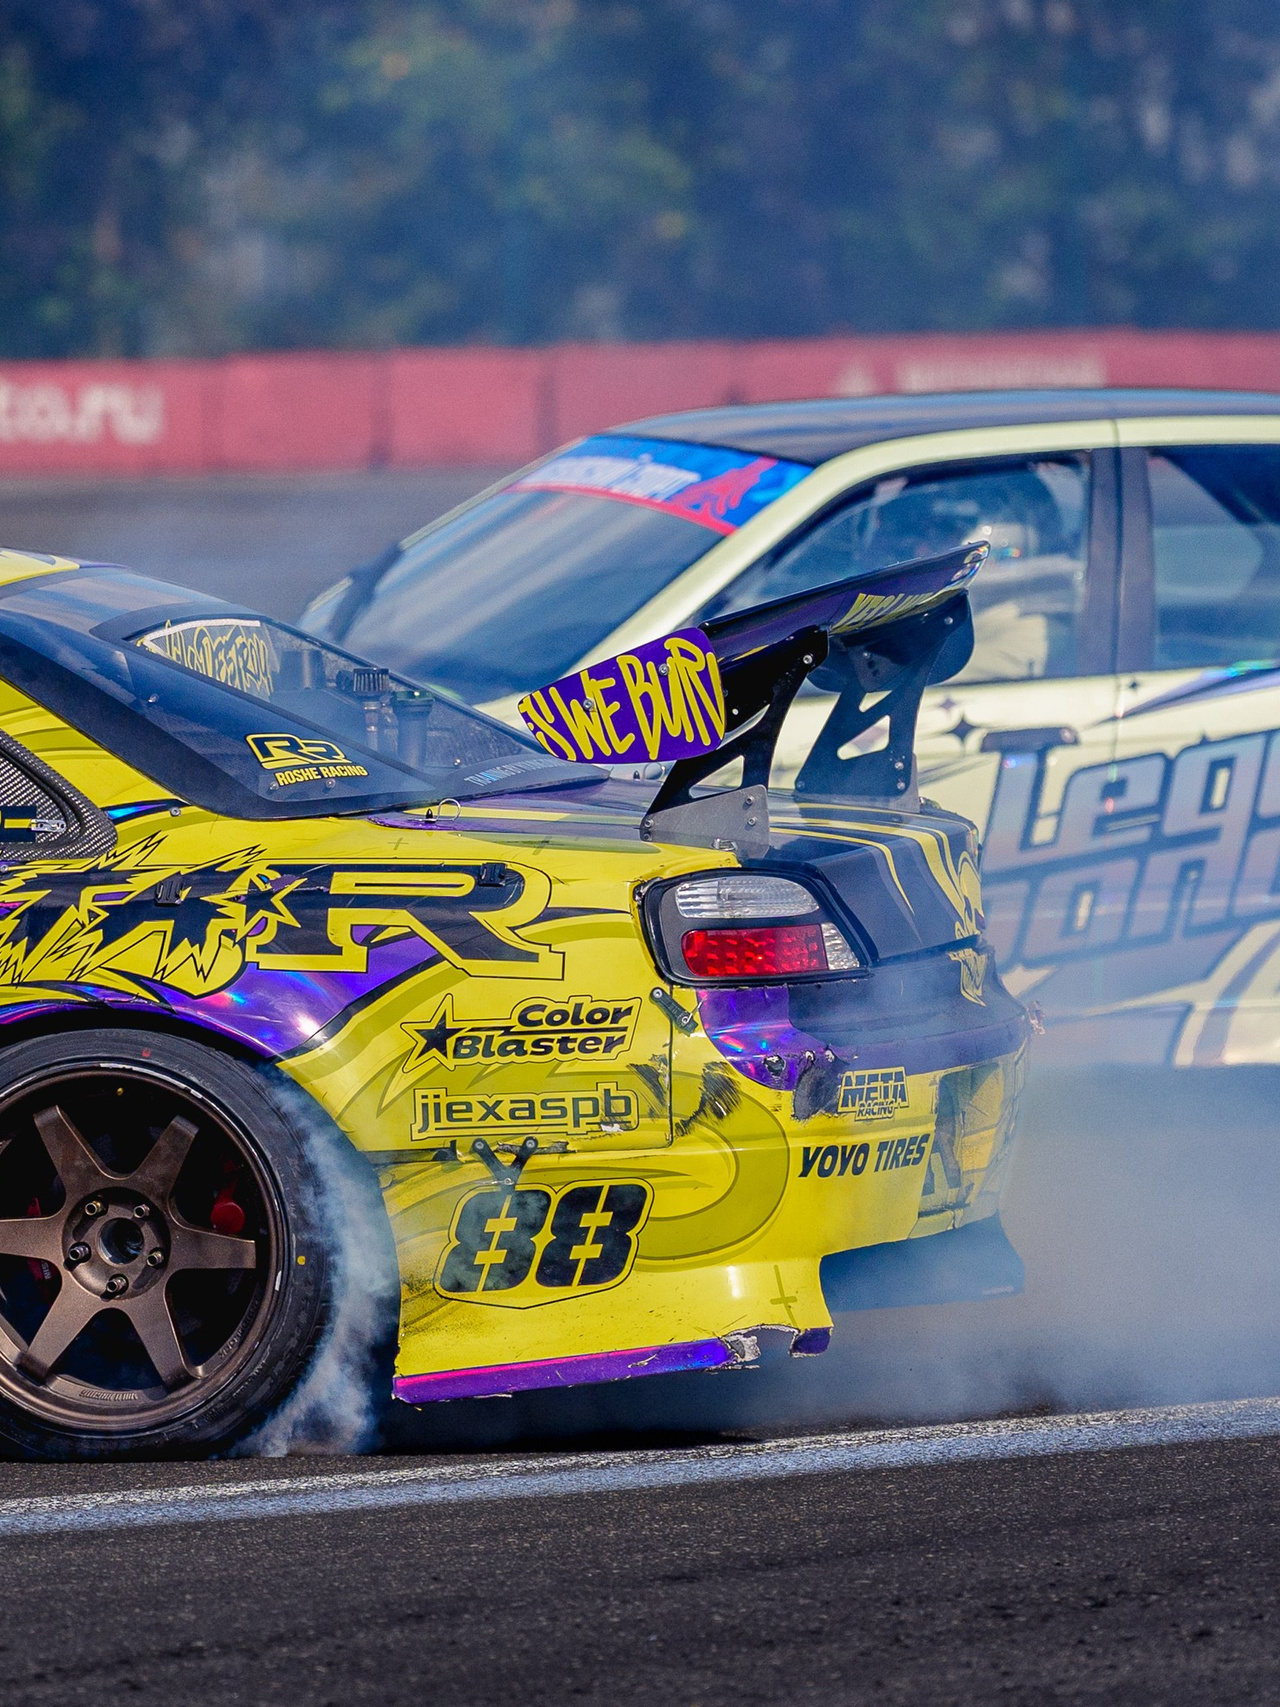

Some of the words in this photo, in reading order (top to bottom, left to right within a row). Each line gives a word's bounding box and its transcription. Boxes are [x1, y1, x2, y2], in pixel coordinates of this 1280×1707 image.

[274, 767, 322, 786] ROSHE
[319, 765, 368, 779] RACING
[517, 1002, 634, 1028] Color
[451, 1033, 626, 1060] Blaster
[417, 1088, 632, 1133] jiexaspb
[856, 1101, 895, 1118] RACING
[798, 1142, 871, 1178] YOYO
[873, 1133, 932, 1173] TIRES
[438, 1182, 653, 1294] 88
